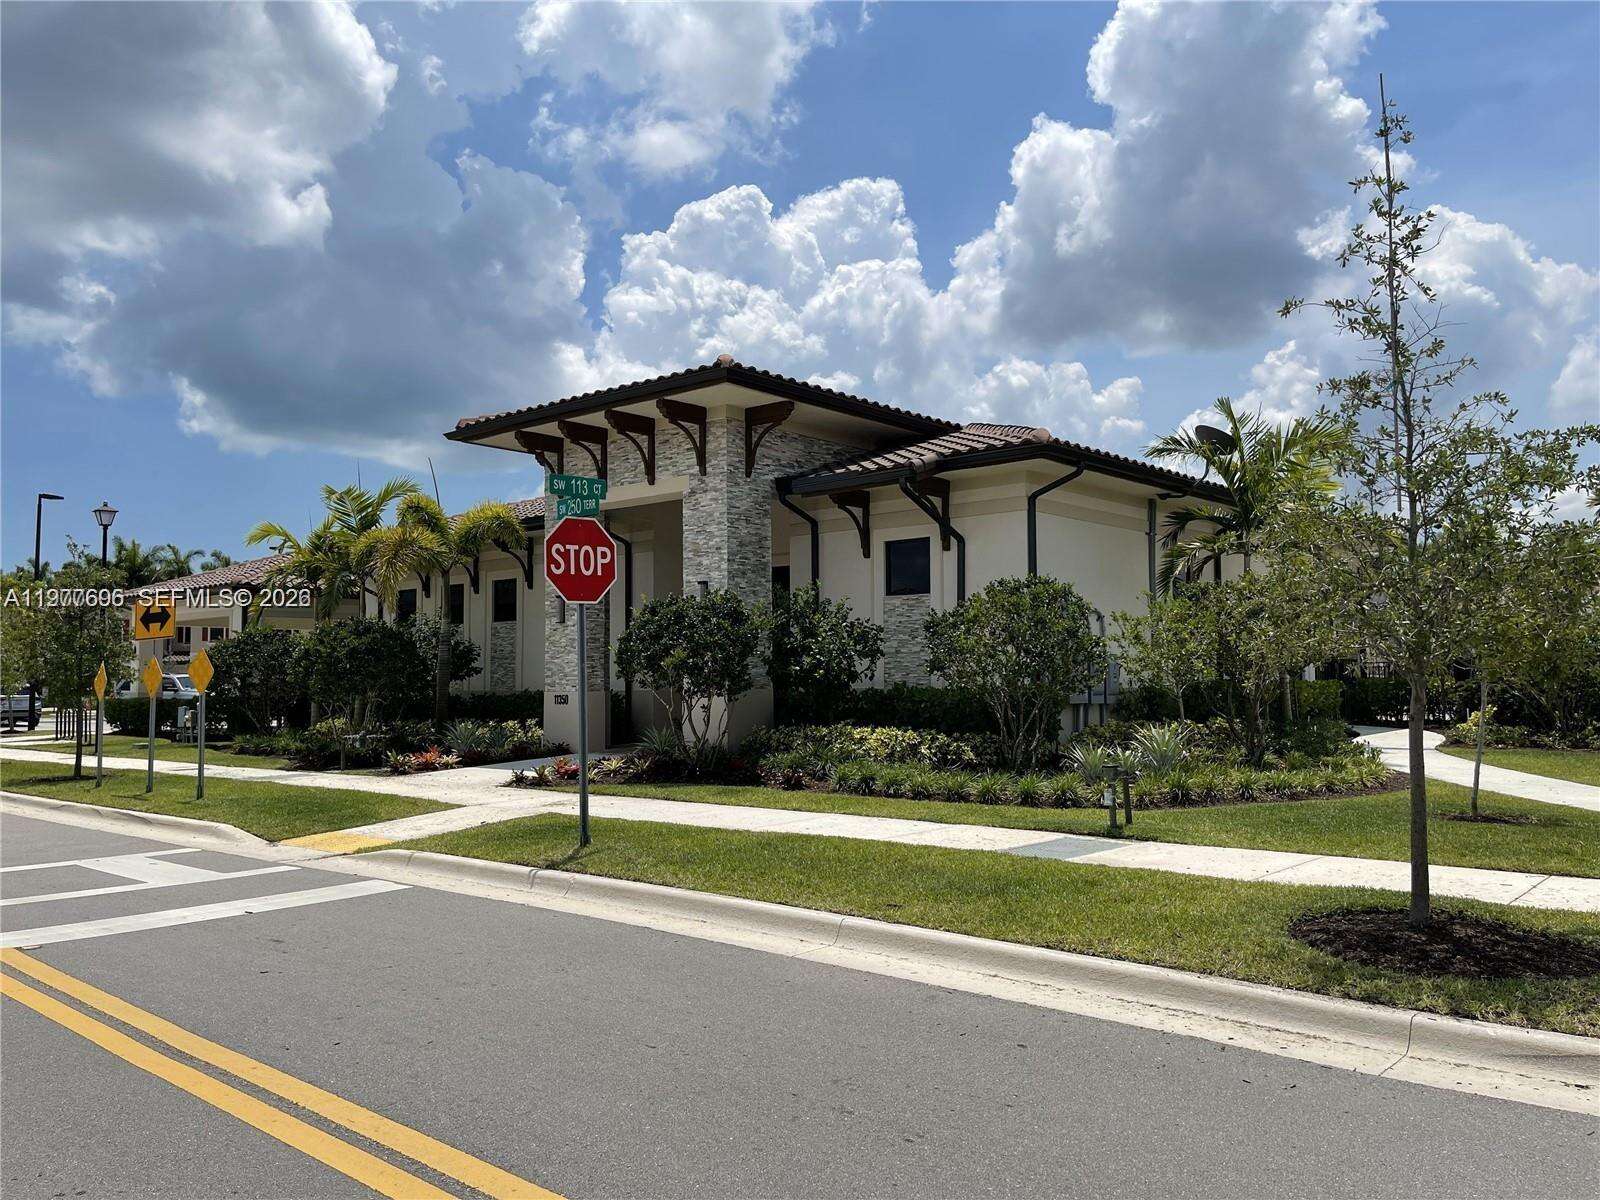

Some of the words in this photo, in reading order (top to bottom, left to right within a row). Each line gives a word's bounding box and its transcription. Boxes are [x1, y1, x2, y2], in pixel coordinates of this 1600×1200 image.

[553, 479, 566, 490] SW
[571, 478, 588, 496] 113
[593, 483, 602, 495] CT
[567, 498, 582, 516] 250
[583, 498, 596, 510] TERR
[550, 543, 611, 576] STOP
[554, 694, 568, 705] 11350
